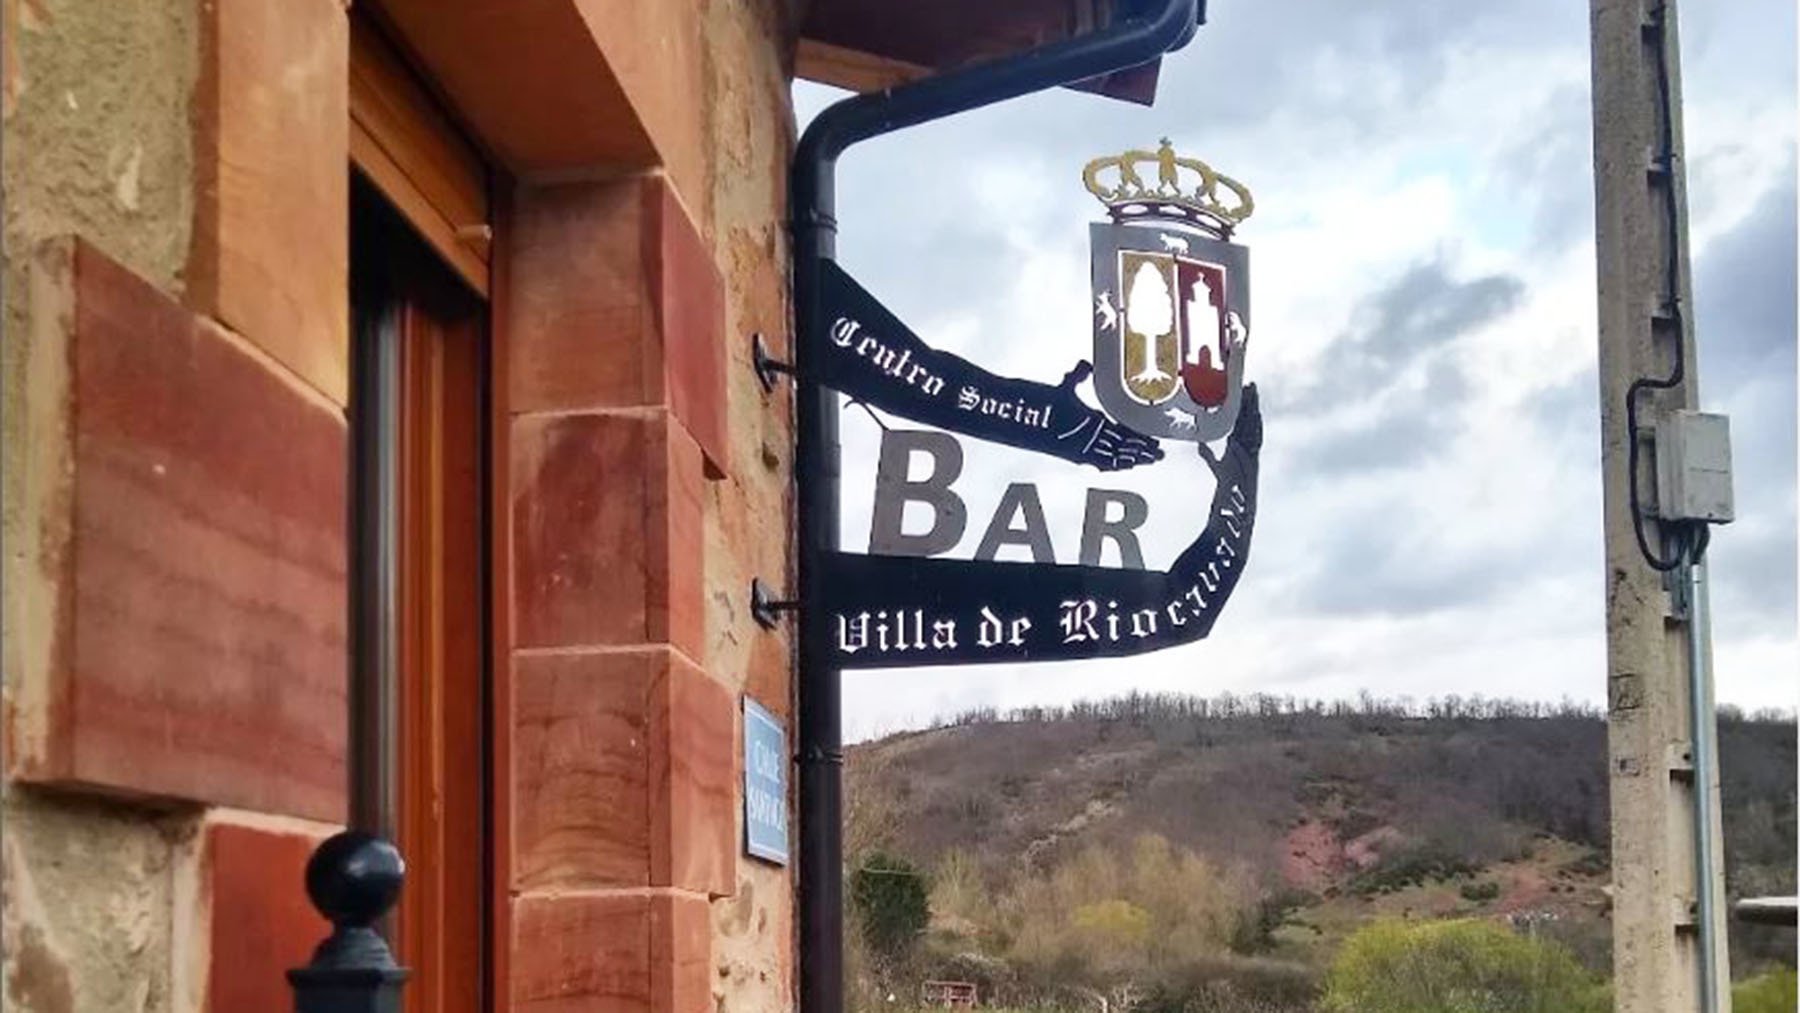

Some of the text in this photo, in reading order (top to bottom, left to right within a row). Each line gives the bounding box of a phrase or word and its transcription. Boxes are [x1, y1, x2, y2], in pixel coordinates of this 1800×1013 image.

[830, 317, 1052, 428] Centro Social
[838, 484, 1246, 653] Villa de Riocavado
[868, 428, 1149, 570] BAR
